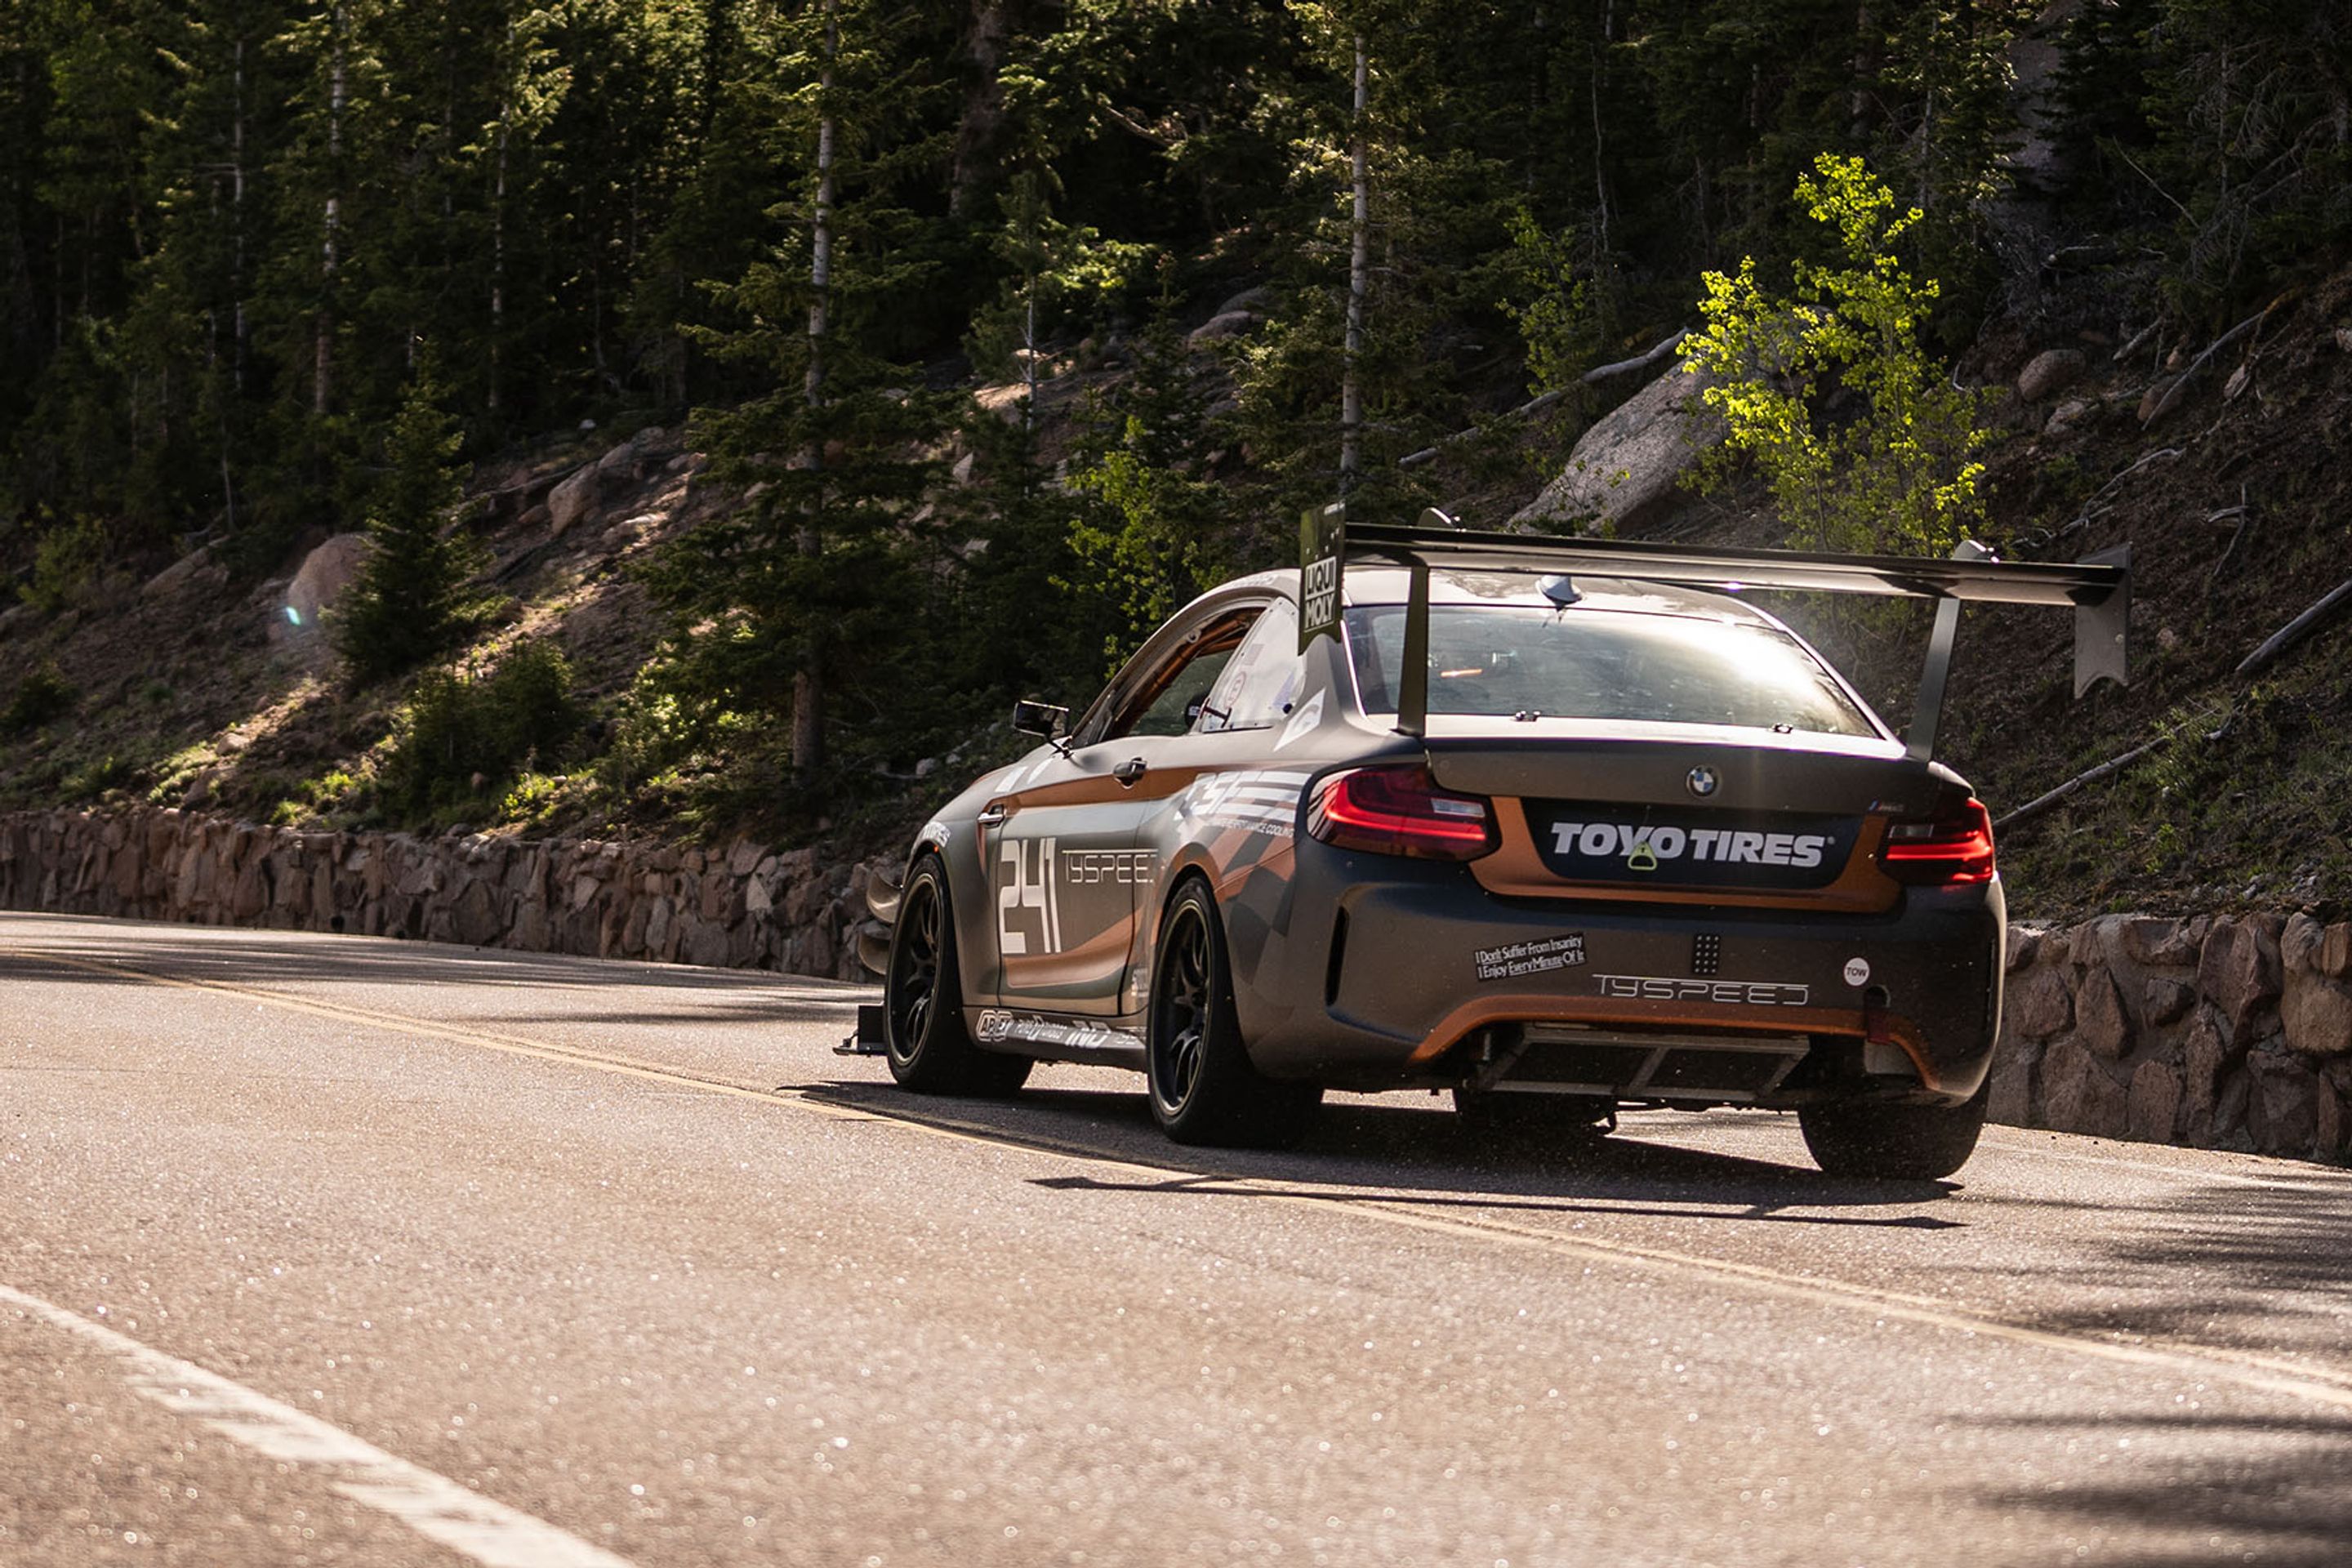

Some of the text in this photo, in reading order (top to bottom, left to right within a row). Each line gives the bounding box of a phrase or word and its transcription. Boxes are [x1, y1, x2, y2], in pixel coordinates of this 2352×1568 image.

[1307, 559, 1335, 596] LIQUI
[1306, 593, 1334, 628] MOLY
[1551, 822, 1827, 868] TOYO TIRES
[1062, 849, 1159, 883] TYSPEE
[999, 837, 1061, 954] 241
[1484, 964, 1508, 978] Enjoy
[1508, 960, 1533, 975] Every
[1532, 956, 1563, 970] Minute
[1562, 950, 1575, 964] Of
[1502, 944, 1528, 960] Suffer
[1527, 942, 1551, 956] From
[1551, 935, 1583, 951] Insanity
[1846, 966, 1868, 977] TOW
